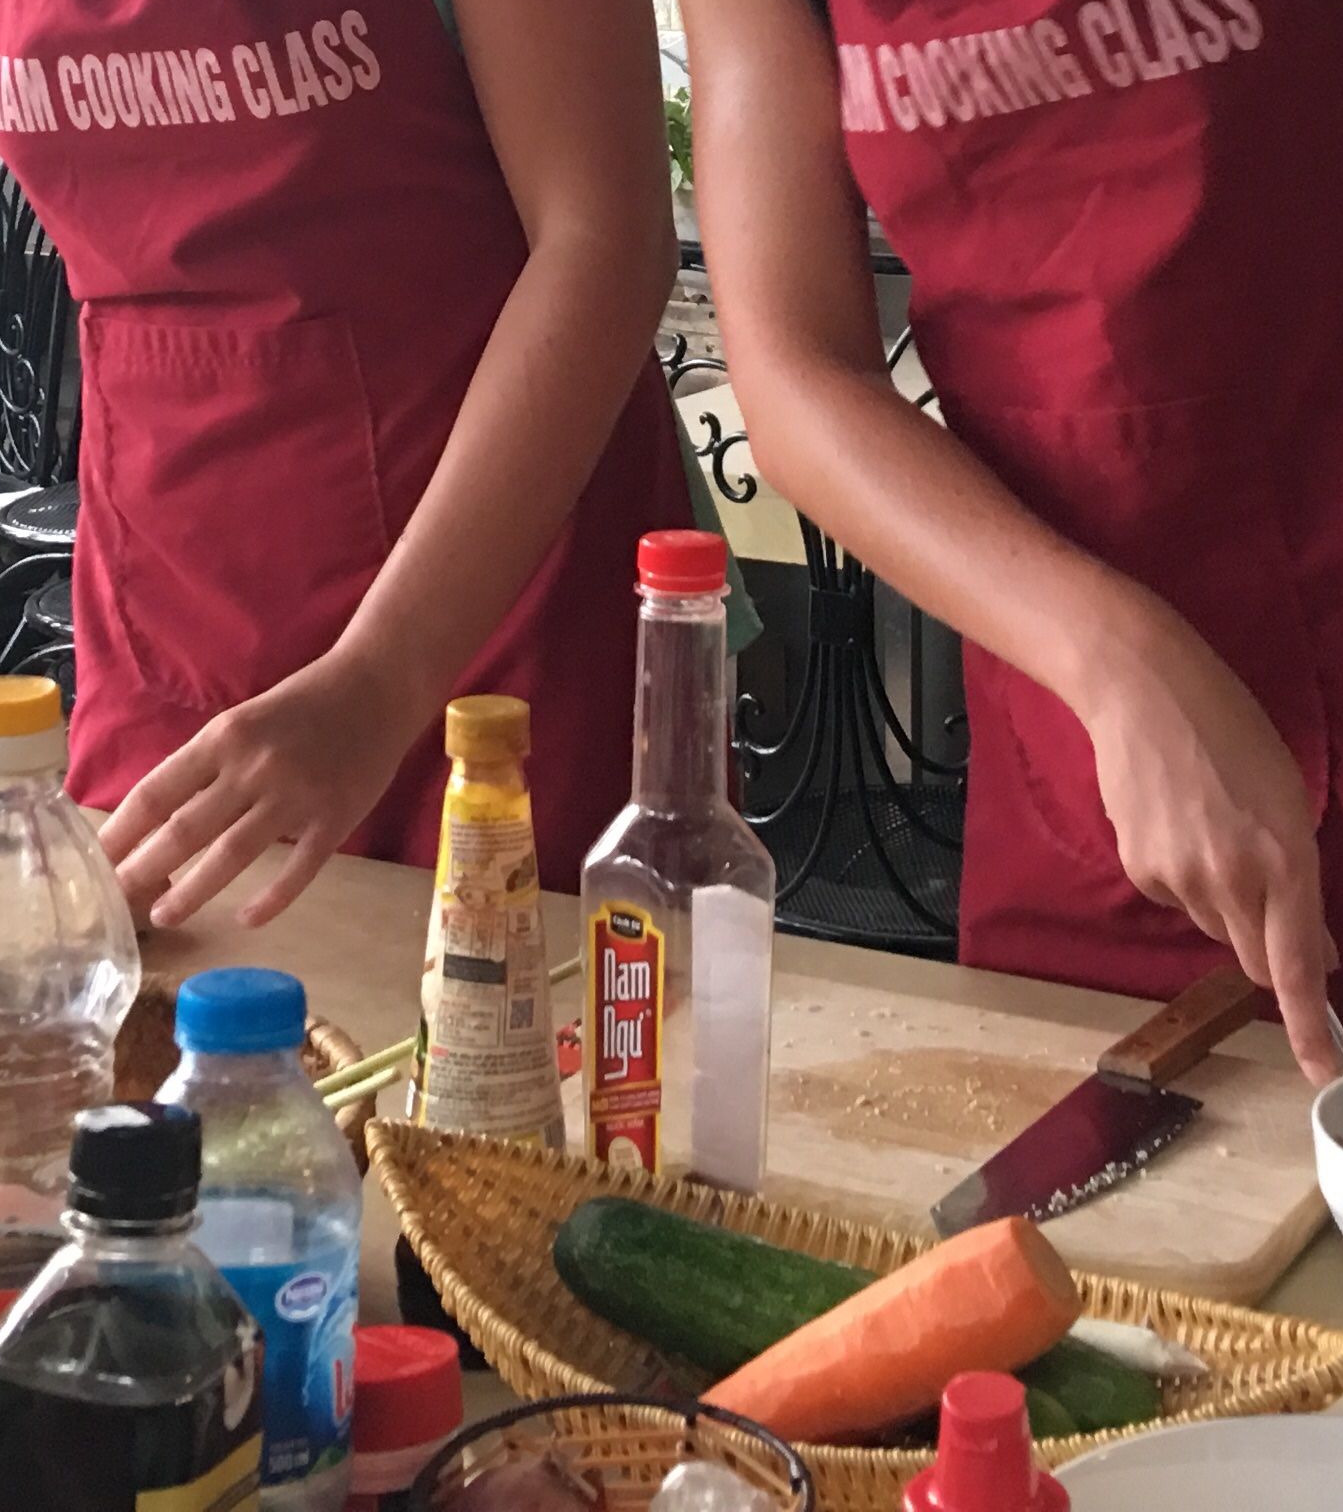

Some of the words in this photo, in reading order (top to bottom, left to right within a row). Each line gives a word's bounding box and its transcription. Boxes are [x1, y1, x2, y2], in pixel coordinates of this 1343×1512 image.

[57, 48, 236, 131] COOKING
[232, 9, 382, 121] CLASS
[877, 18, 1093, 133] COOKING
[603, 947, 651, 1001] Nam
